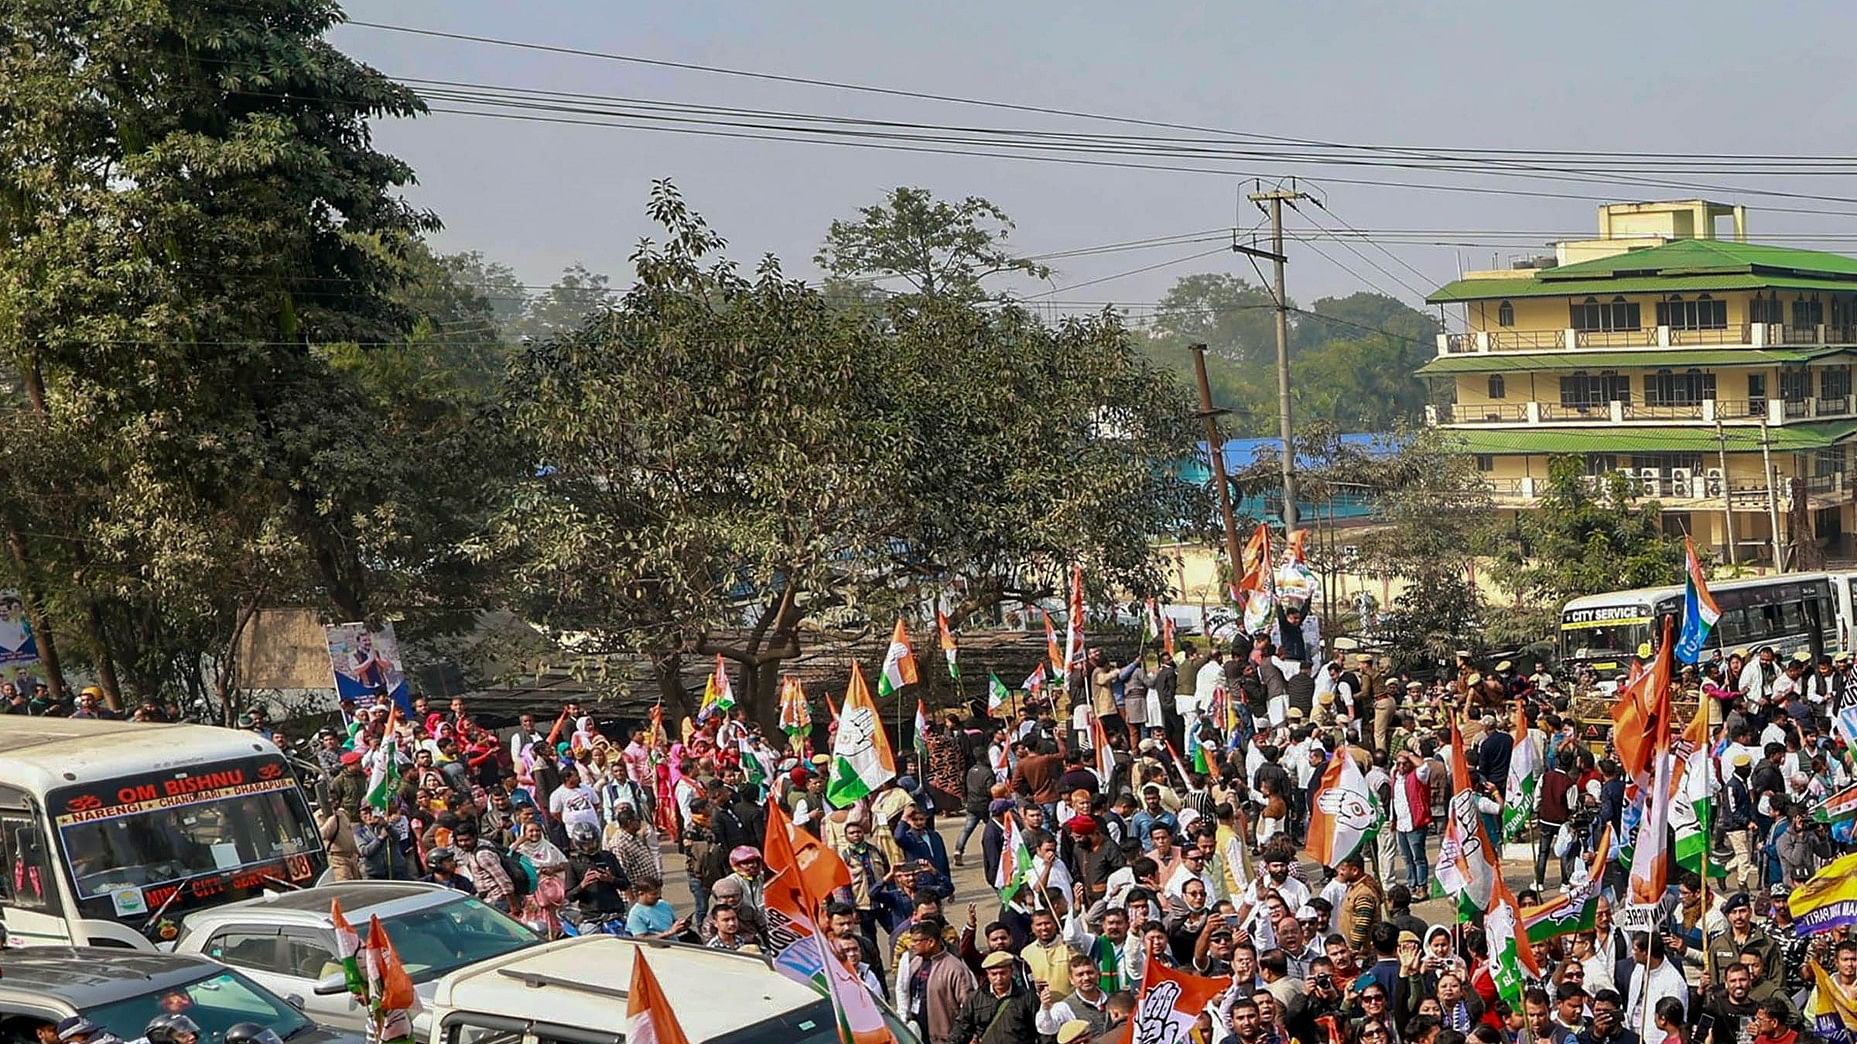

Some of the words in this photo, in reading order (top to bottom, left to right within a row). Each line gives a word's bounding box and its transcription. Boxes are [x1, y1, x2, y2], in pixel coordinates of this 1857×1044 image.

[1572, 610, 1594, 622] CITY
[1596, 607, 1638, 621] SERVICE
[71, 803, 144, 823] NARENGI
[234, 779, 288, 796] DHARAPUR
[116, 786, 157, 804] OM
[164, 769, 244, 796] BISHNU
[288, 856, 309, 879] 38
